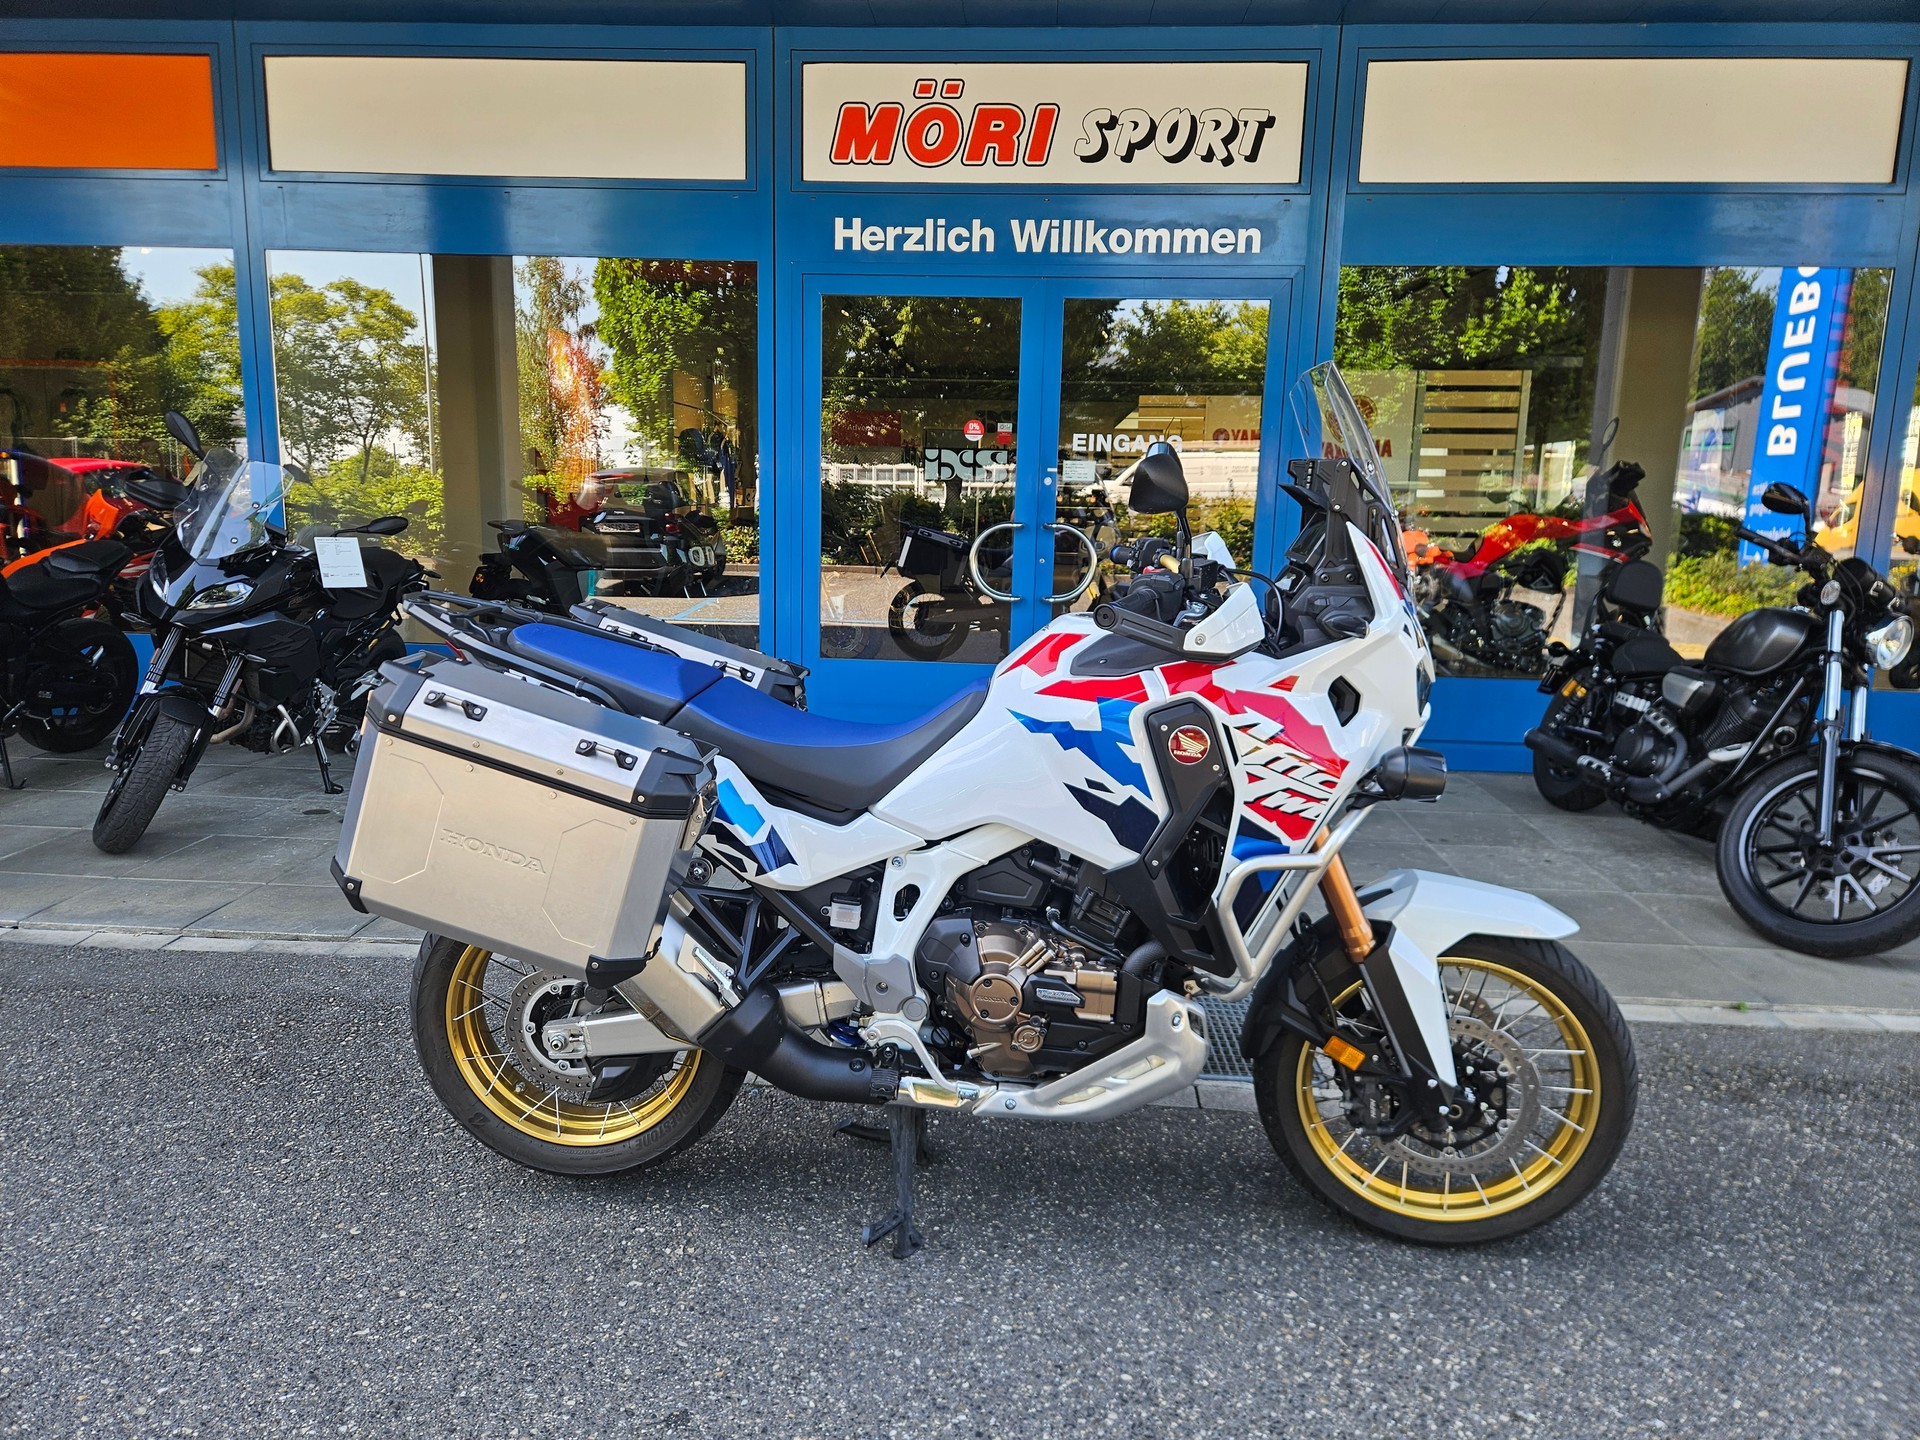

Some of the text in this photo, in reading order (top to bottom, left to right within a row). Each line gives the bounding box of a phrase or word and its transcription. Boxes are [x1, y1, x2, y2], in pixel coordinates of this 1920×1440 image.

[829, 78, 1276, 168] MÖRI SPORT
[834, 216, 1261, 254] Herzlich Willkommen
[1173, 749, 1202, 758] HONDA
[440, 828, 546, 874] HONDA
